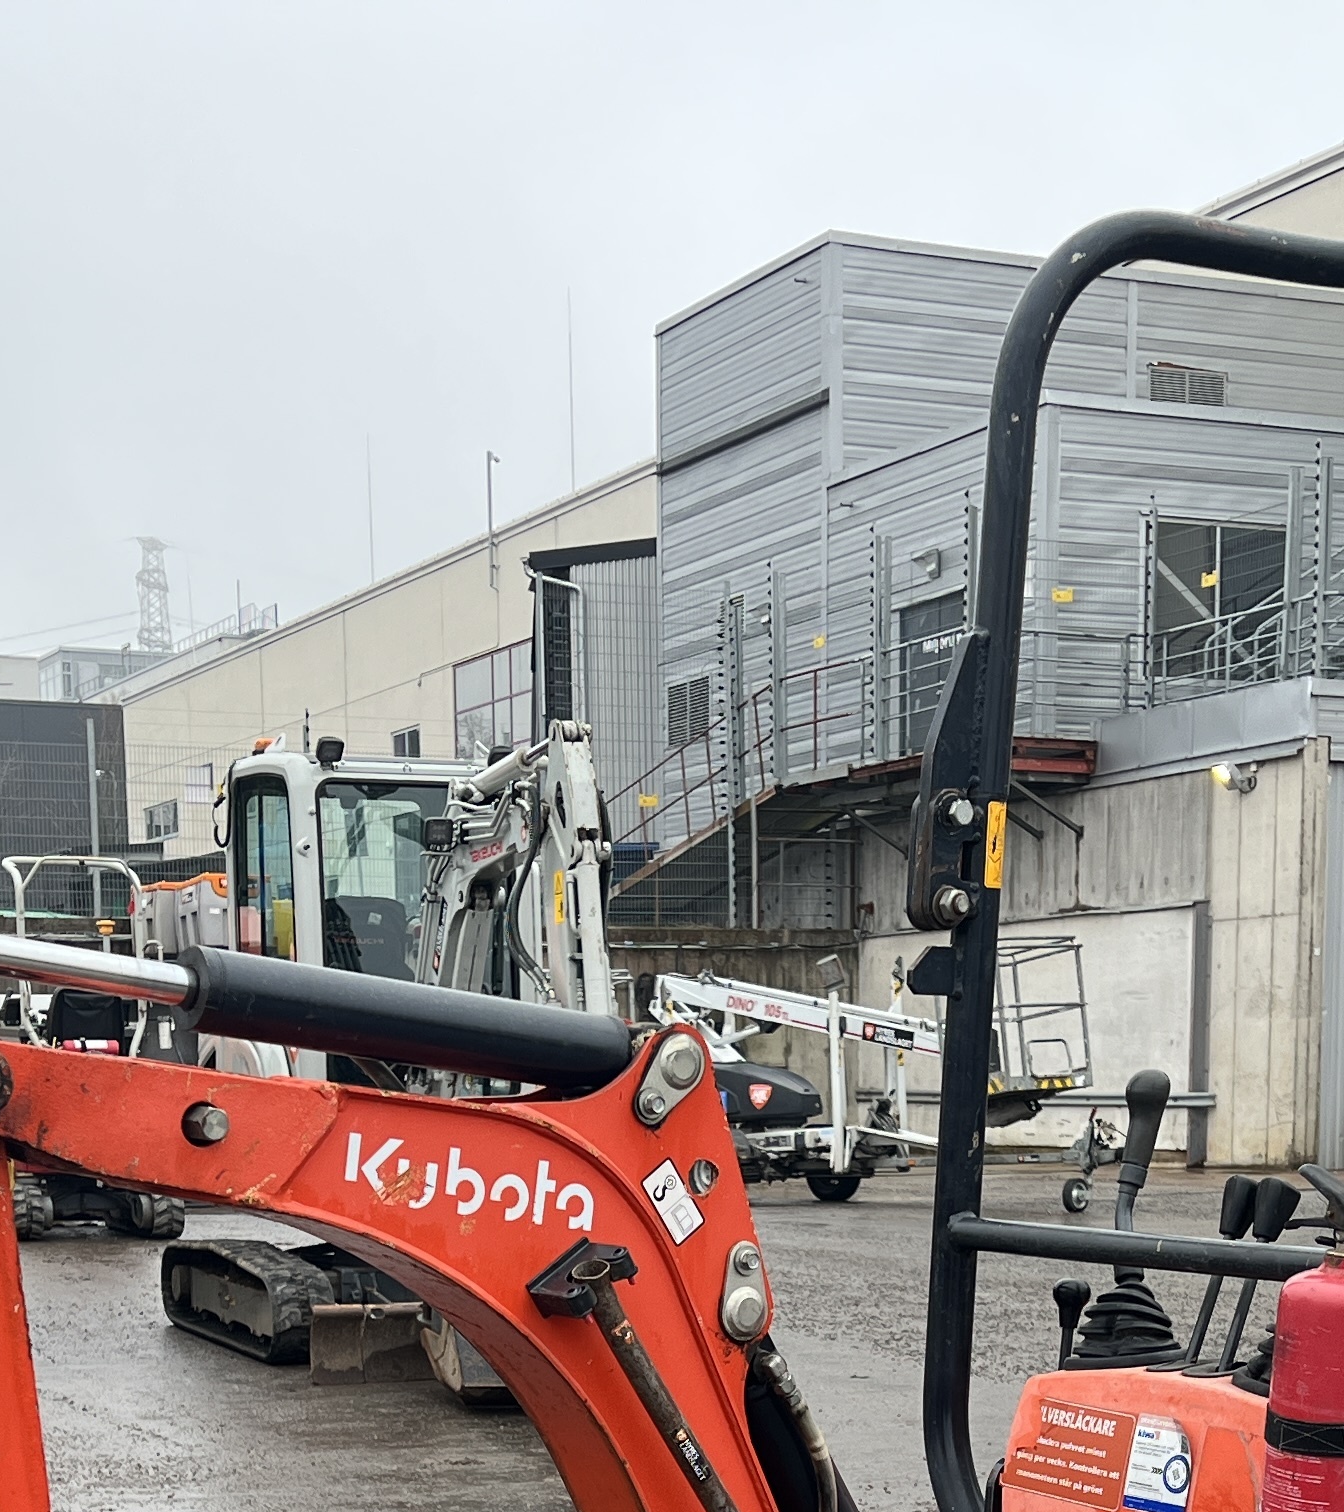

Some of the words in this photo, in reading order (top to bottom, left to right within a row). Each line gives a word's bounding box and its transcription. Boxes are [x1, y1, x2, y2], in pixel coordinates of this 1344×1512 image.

[726, 995, 755, 1012] DINO
[343, 1131, 595, 1232] Kubota
[1041, 1405, 1117, 1437] LVERSLÄCKARE
